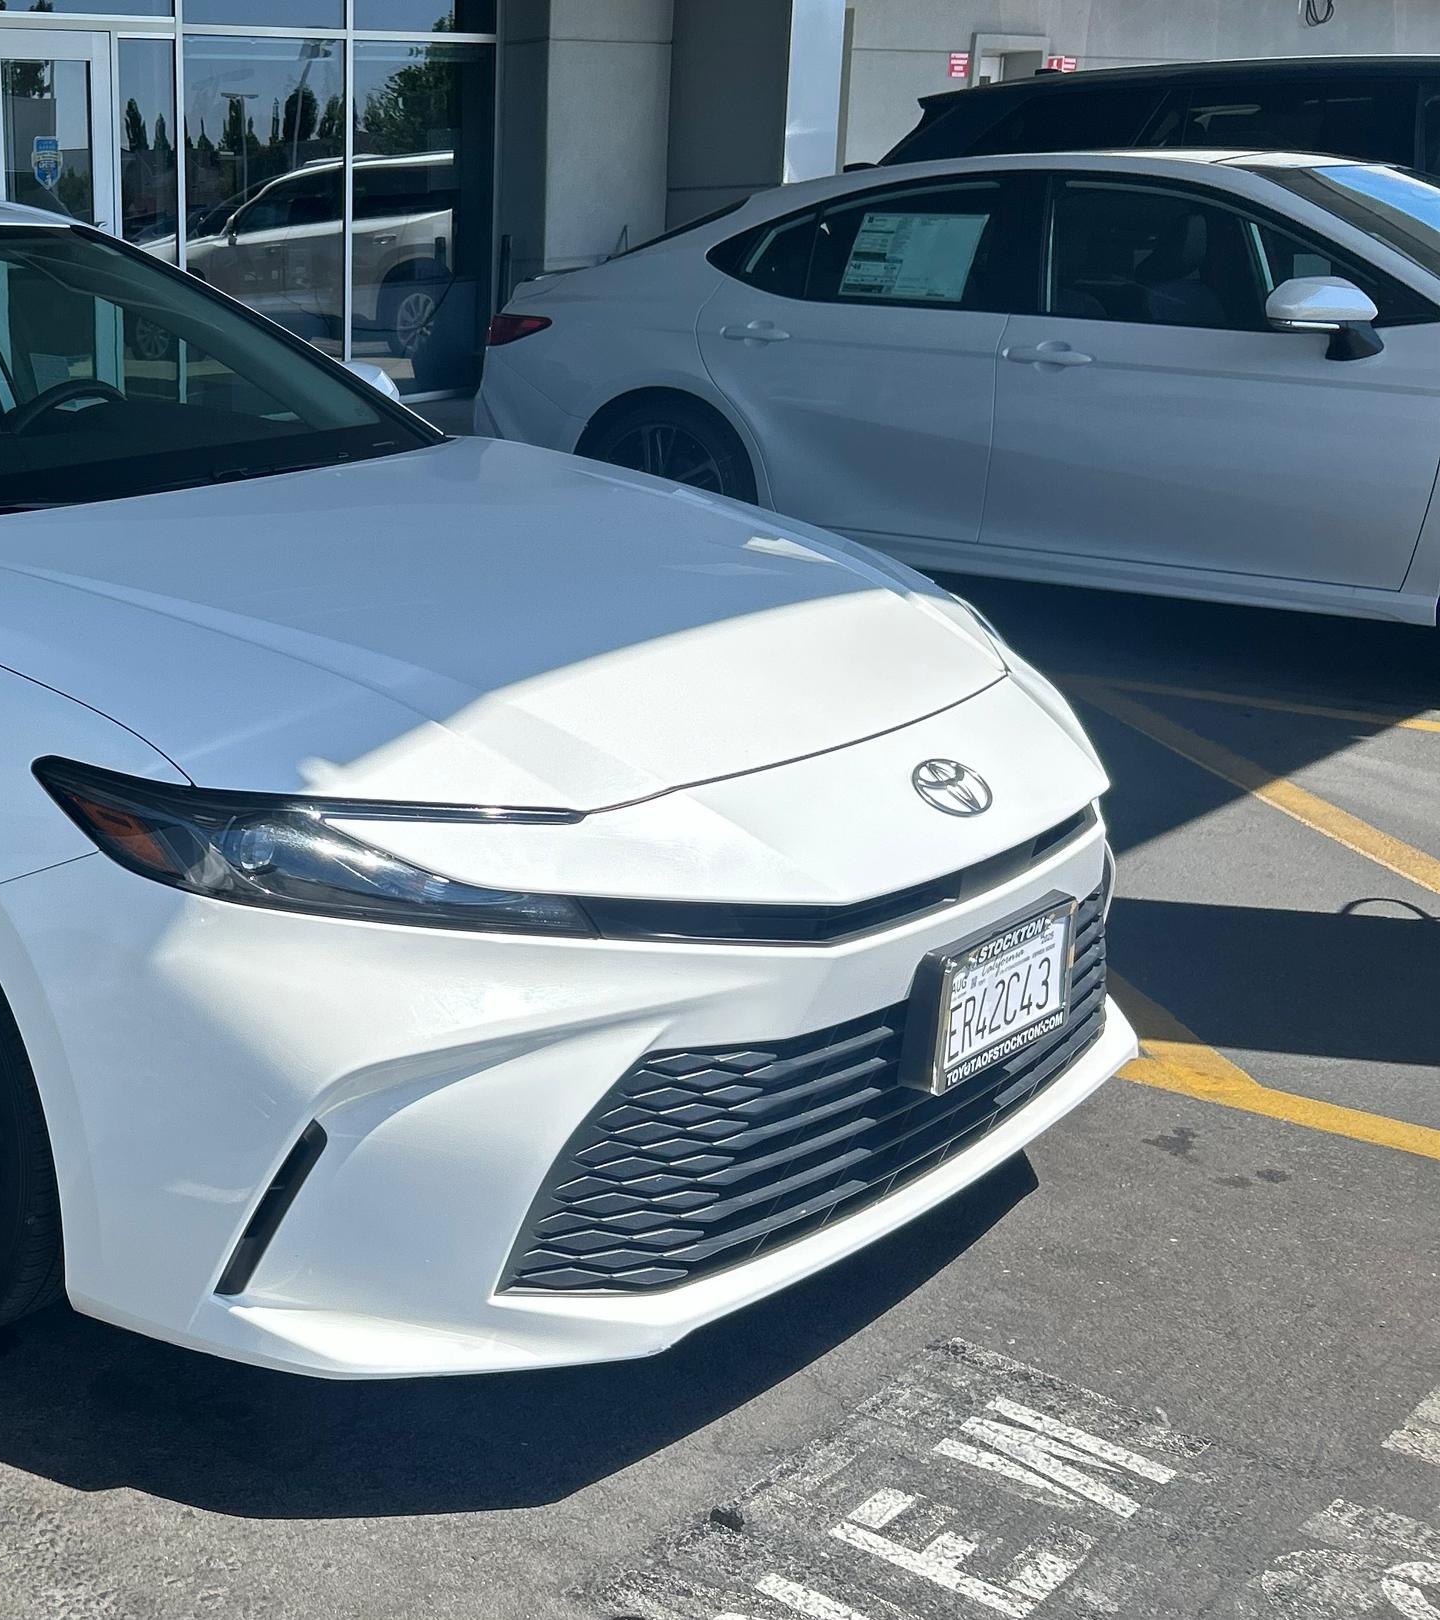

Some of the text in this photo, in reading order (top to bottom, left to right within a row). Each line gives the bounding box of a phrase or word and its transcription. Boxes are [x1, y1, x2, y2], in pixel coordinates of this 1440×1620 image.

[978, 917, 1046, 963] STOCKTON
[947, 957, 1051, 1063] ER42C43
[952, 976, 968, 994] AUG
[946, 1012, 1064, 1087] TOYOTAOFSTOCKTON.COM
